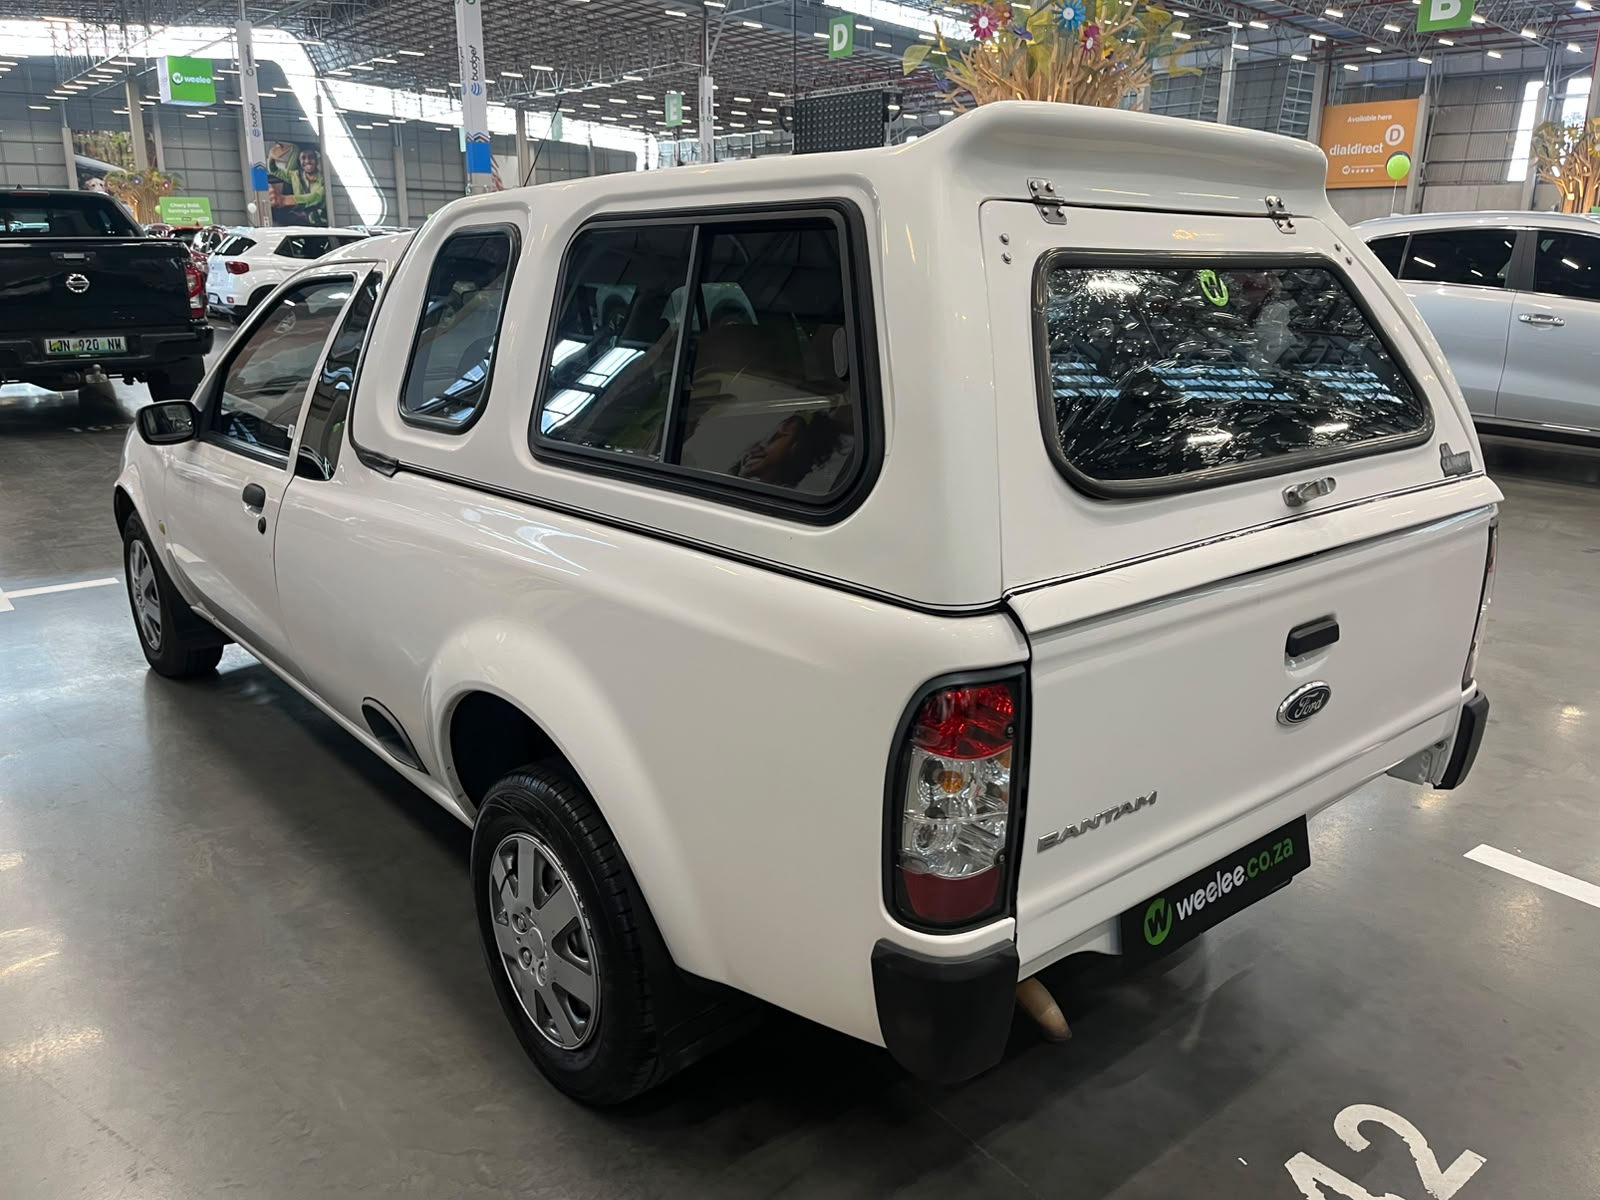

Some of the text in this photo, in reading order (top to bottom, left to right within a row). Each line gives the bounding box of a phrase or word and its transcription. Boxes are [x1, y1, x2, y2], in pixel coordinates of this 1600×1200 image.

[833, 23, 848, 51] D
[469, 45, 480, 81] budget
[669, 98, 678, 121] E
[1347, 113, 1393, 123] Available here
[1329, 142, 1384, 156] dialdirect
[79, 339, 99, 351] 920
[1294, 691, 1325, 719] Ford
[1037, 790, 1158, 853] BANTAM
[1176, 837, 1294, 921] weelee.co.za
